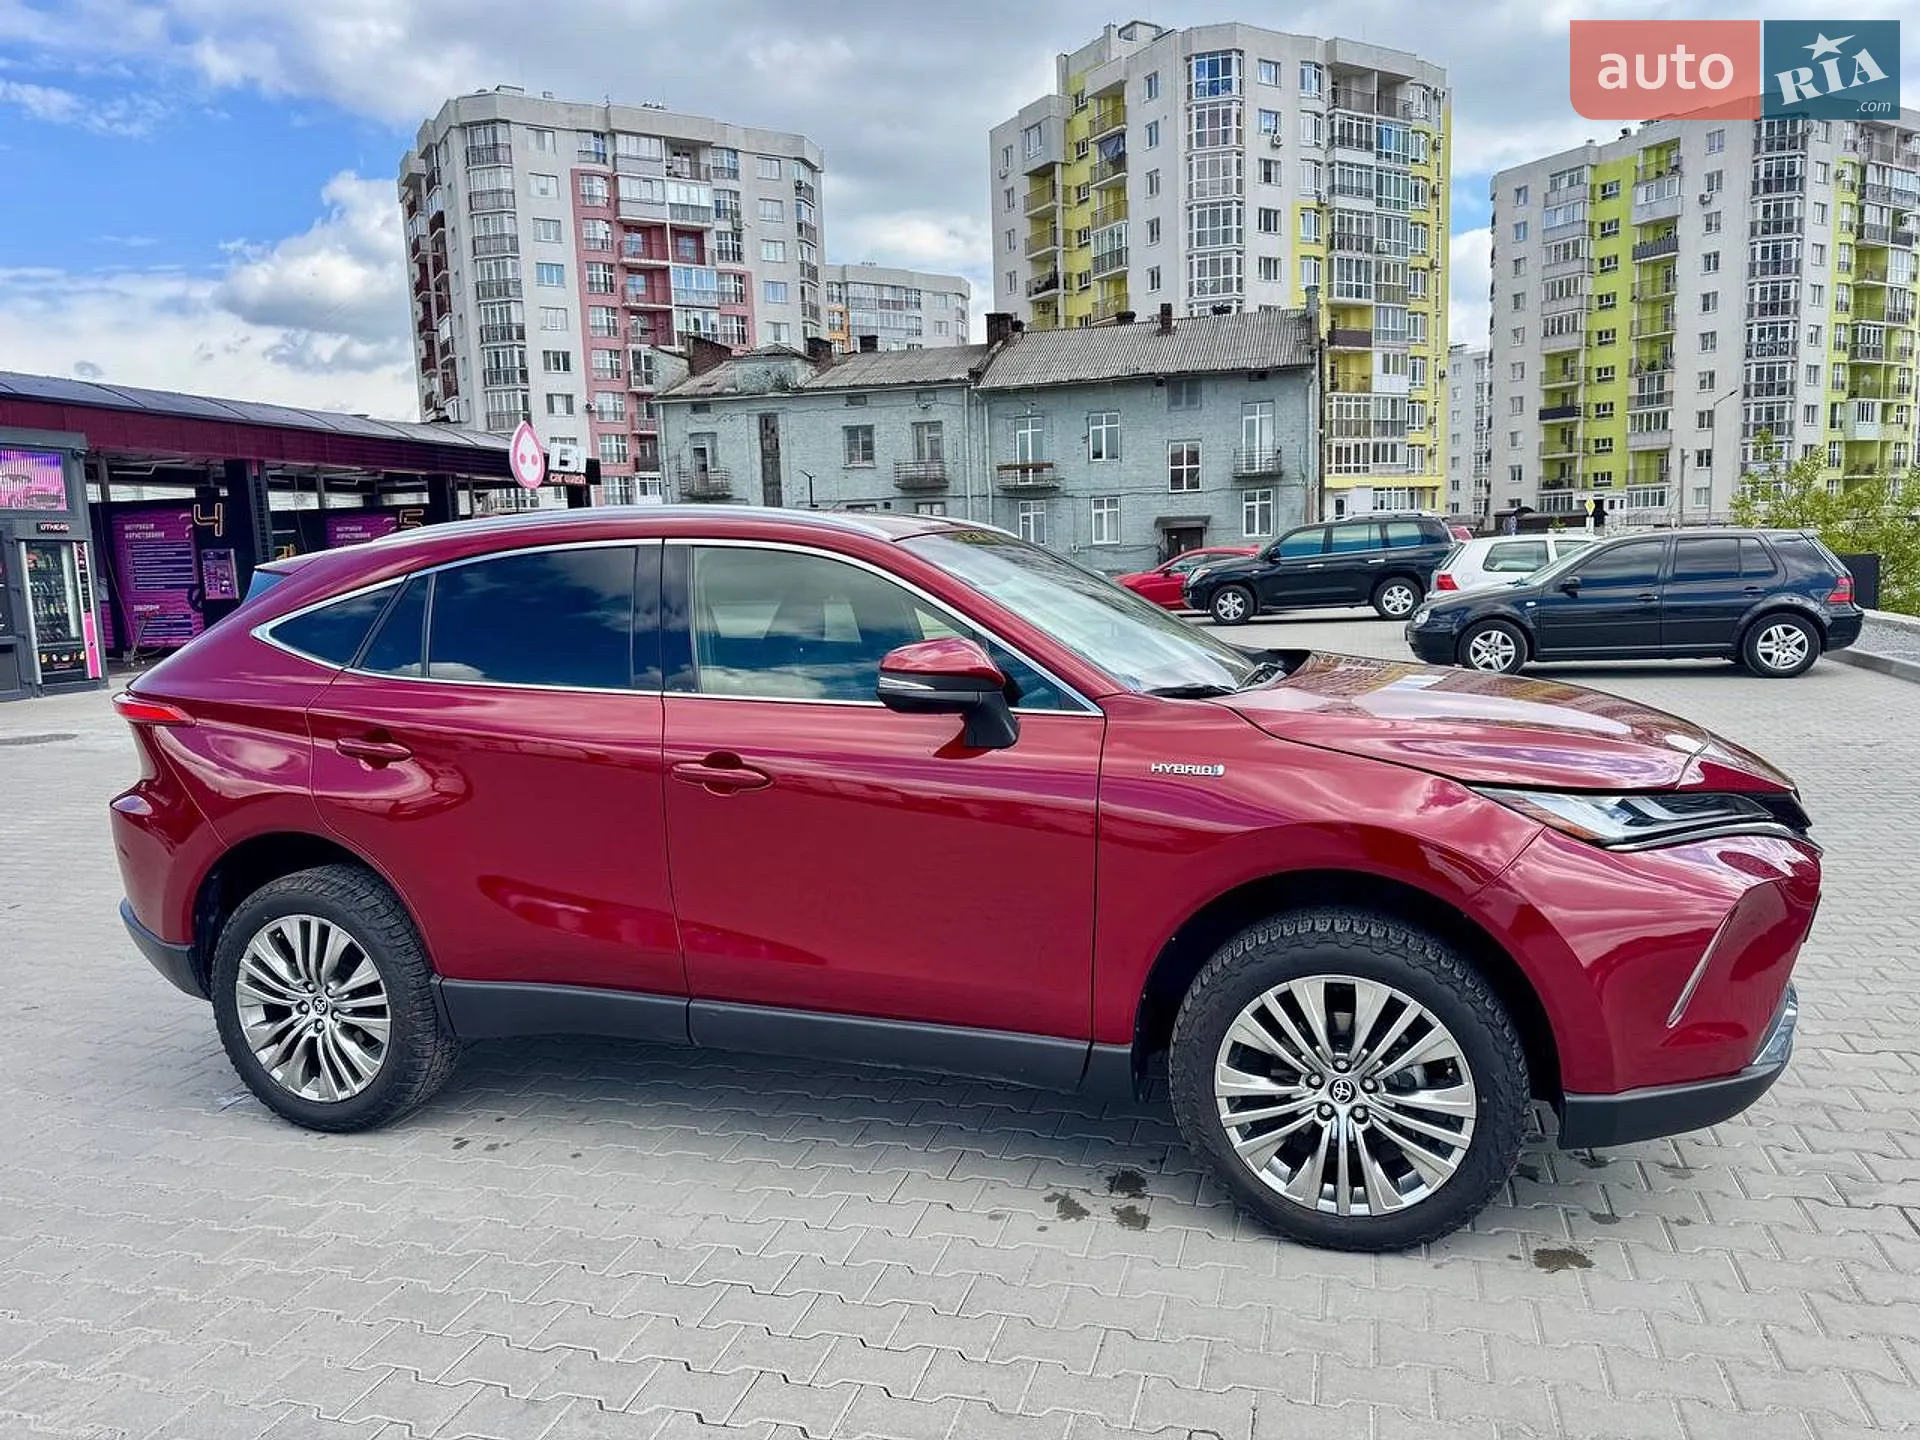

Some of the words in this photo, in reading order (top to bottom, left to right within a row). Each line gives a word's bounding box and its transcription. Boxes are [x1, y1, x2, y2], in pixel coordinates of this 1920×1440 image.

[550, 473, 562, 482] car
[564, 474, 586, 485] wash
[194, 503, 223, 537] 4
[1151, 763, 1214, 775] HYBRID
